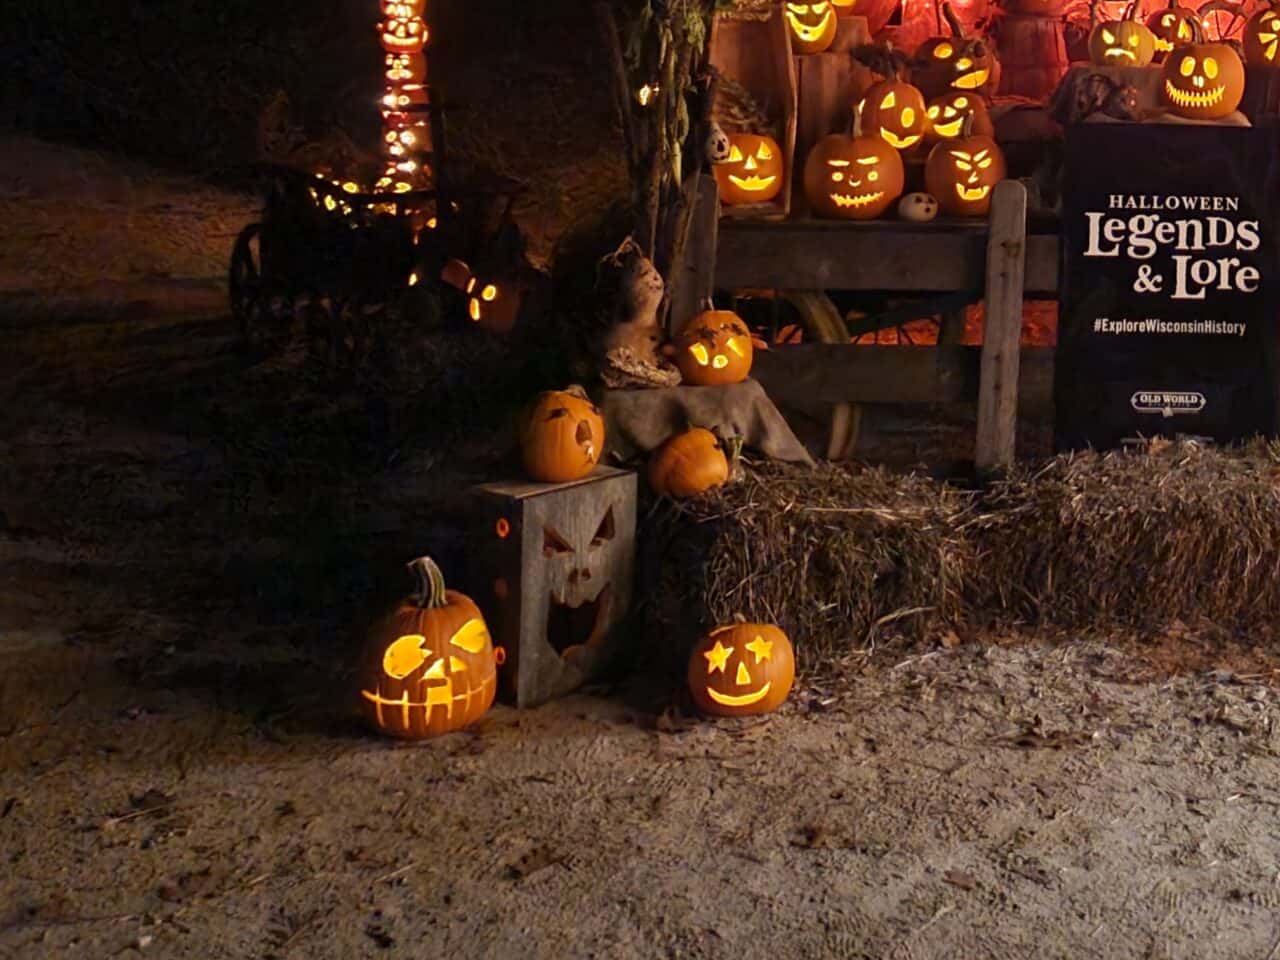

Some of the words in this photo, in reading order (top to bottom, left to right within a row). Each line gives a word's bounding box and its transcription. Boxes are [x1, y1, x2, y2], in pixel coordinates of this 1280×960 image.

[1109, 194, 1239, 211] HALLOWEEN
[1133, 264, 1163, 293] &
[1171, 255, 1260, 300] Lore
[1094, 318, 1246, 336] #ExploreWisconsinHistory
[1140, 394, 1161, 403] OLD
[1162, 394, 1198, 404] WORLD
